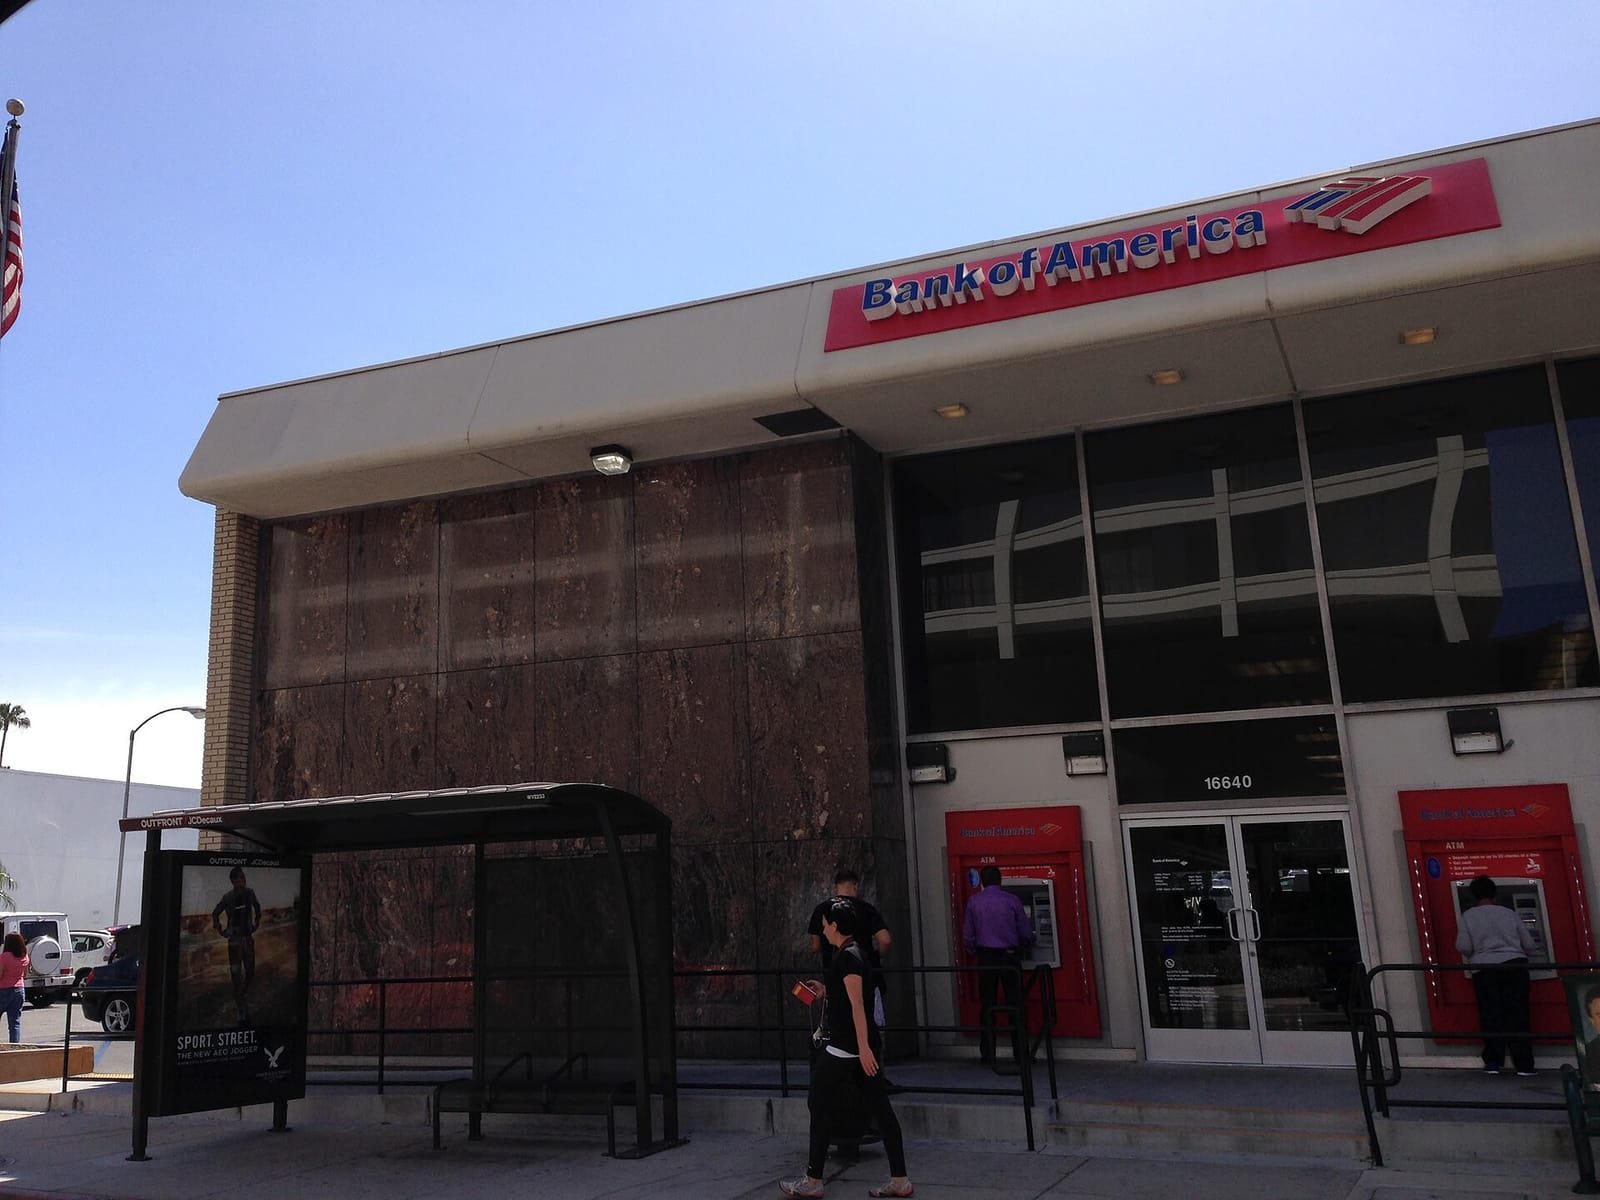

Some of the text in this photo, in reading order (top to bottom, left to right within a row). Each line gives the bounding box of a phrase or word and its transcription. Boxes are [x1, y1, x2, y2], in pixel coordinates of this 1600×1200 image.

[862, 209, 1267, 320] Bank of America
[1204, 775, 1252, 790] 16640
[141, 815, 223, 828] OUTFRONT JCDecaux
[1445, 841, 1464, 849] ATM
[209, 857, 247, 865] OUTFRONT
[980, 856, 996, 864] ATM
[177, 1030, 257, 1050] SPORT. STREET.
[177, 1045, 259, 1060] THE NEW AEO JOGGER
